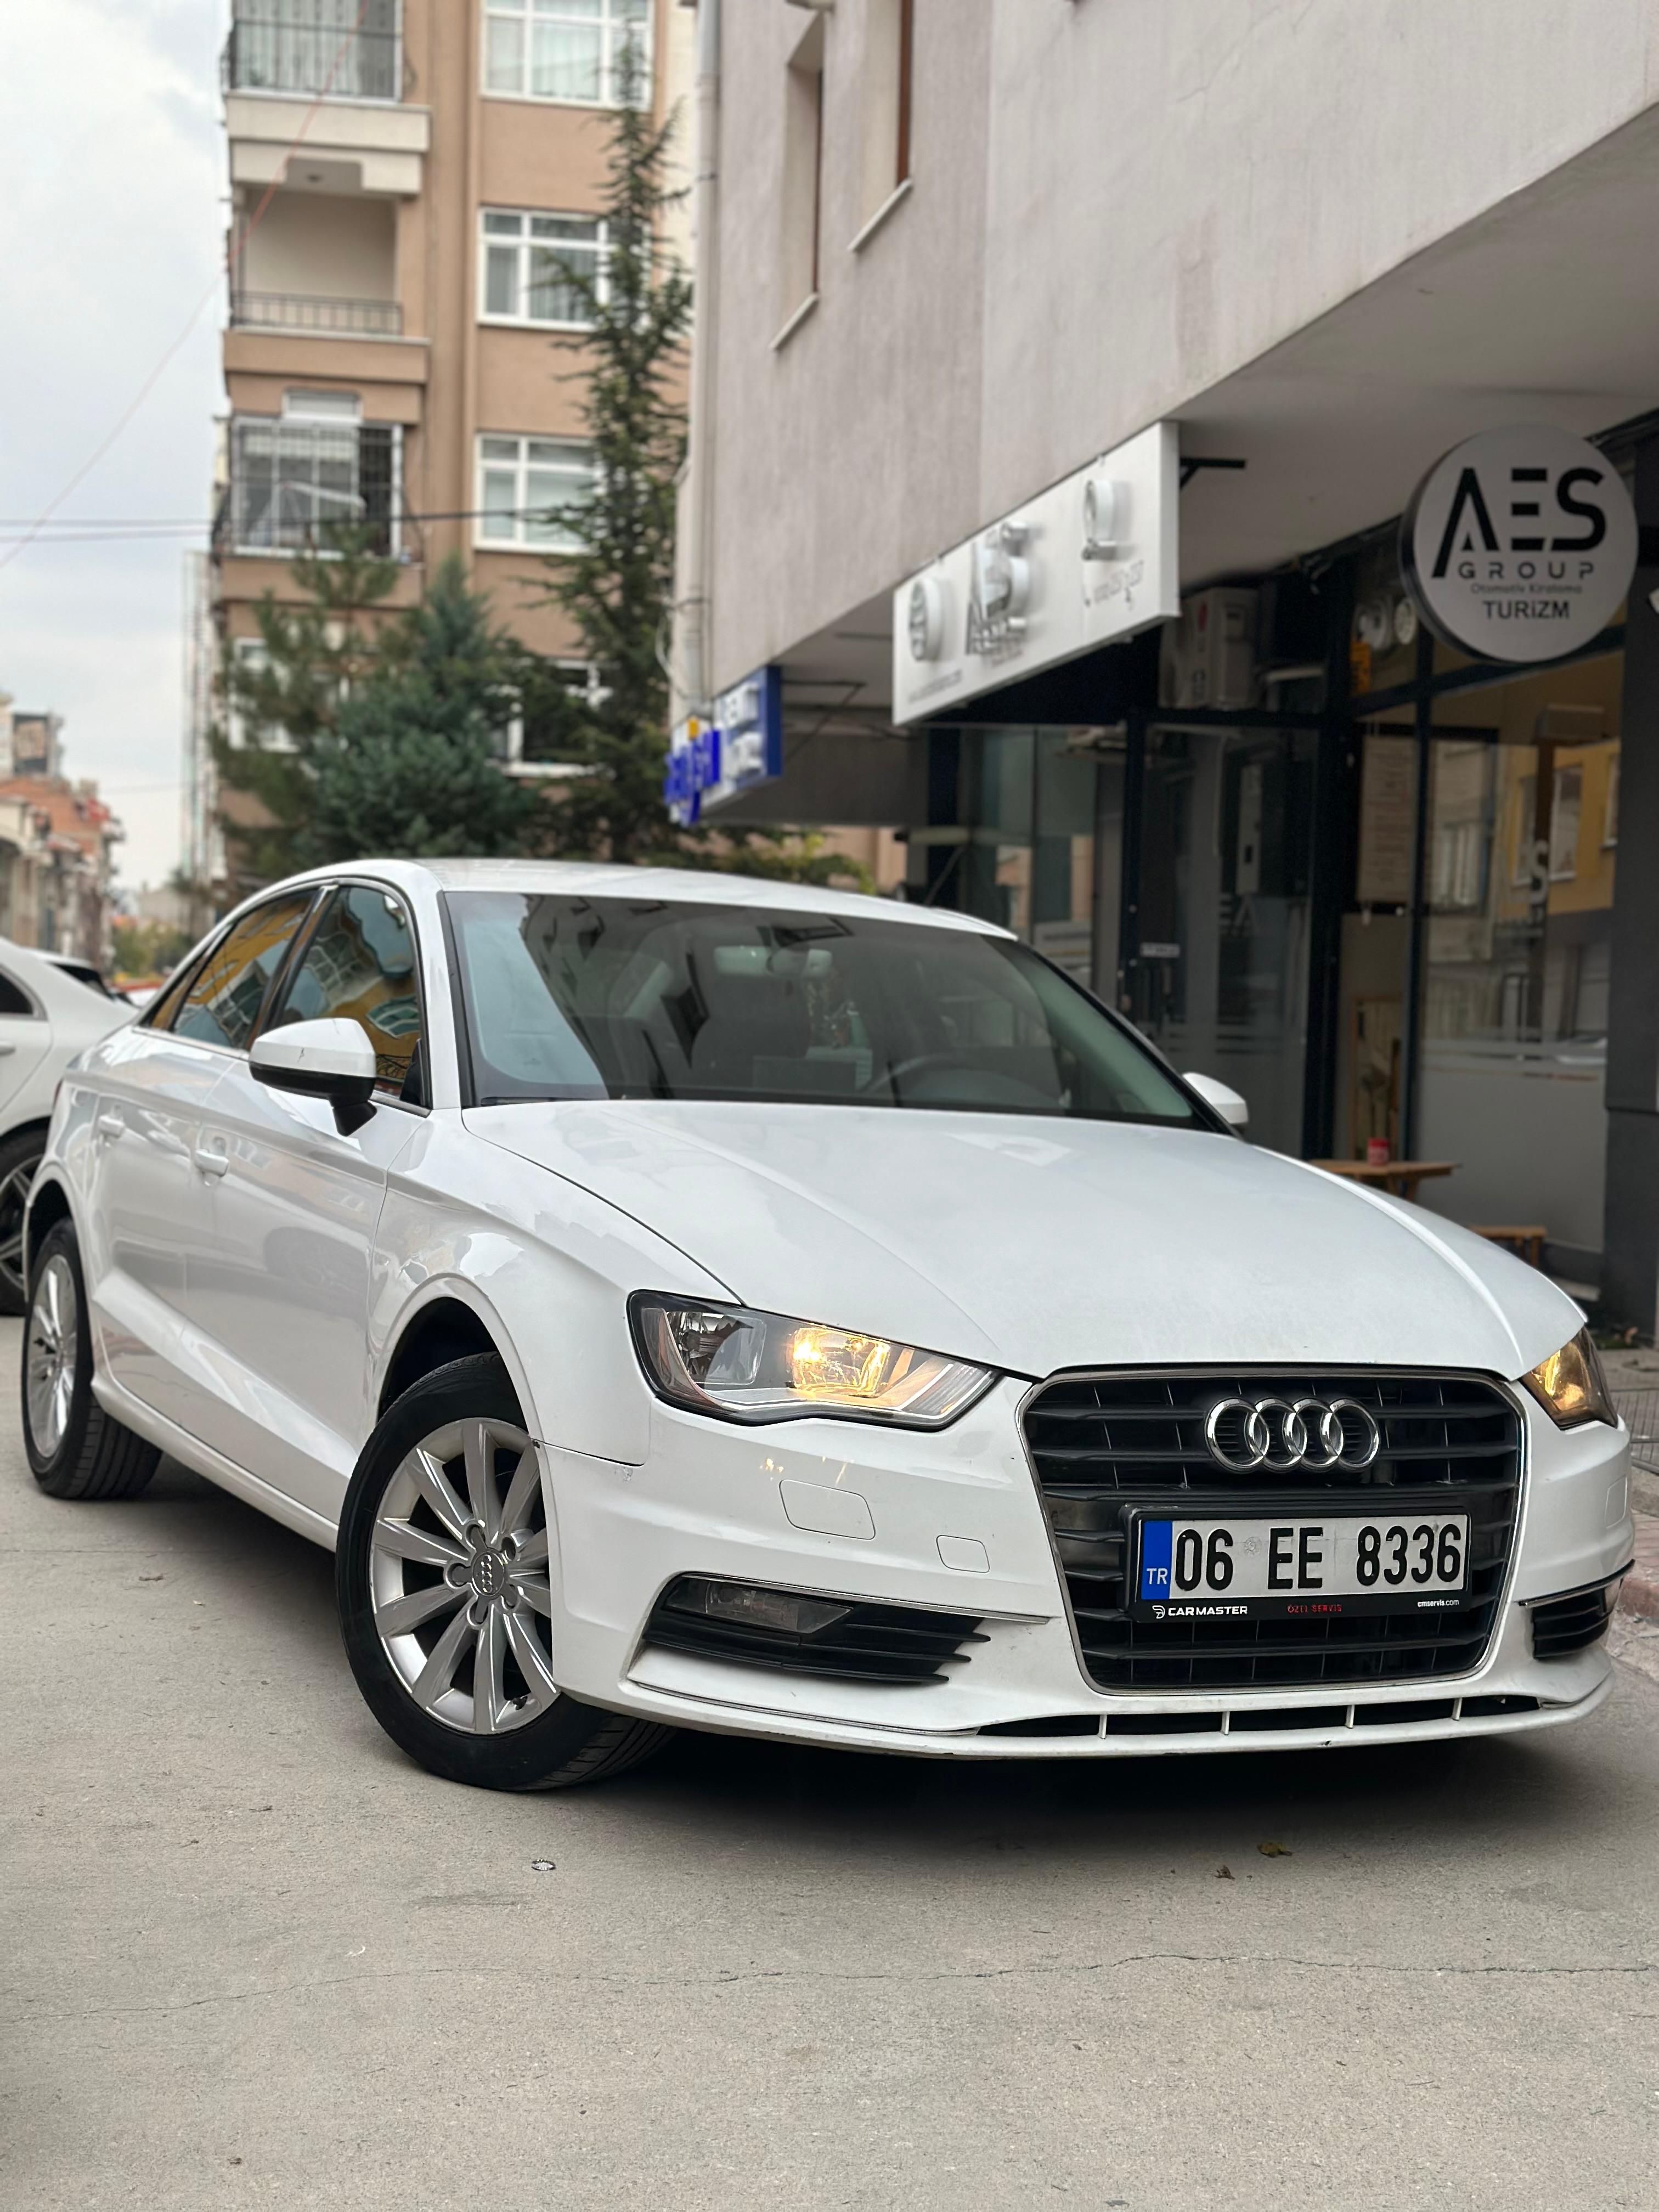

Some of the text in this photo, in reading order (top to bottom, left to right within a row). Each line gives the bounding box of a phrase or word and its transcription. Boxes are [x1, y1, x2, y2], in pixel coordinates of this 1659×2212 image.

[1431, 467, 1607, 578] AES
[1458, 561, 1595, 579] GROUP
[1175, 1523, 1462, 1591] 06 EE 8336
[1147, 1568, 1169, 1584] TR
[1168, 1606, 1248, 1616] CARMASTER
[1417, 1599, 1459, 1607] cmservis.com
